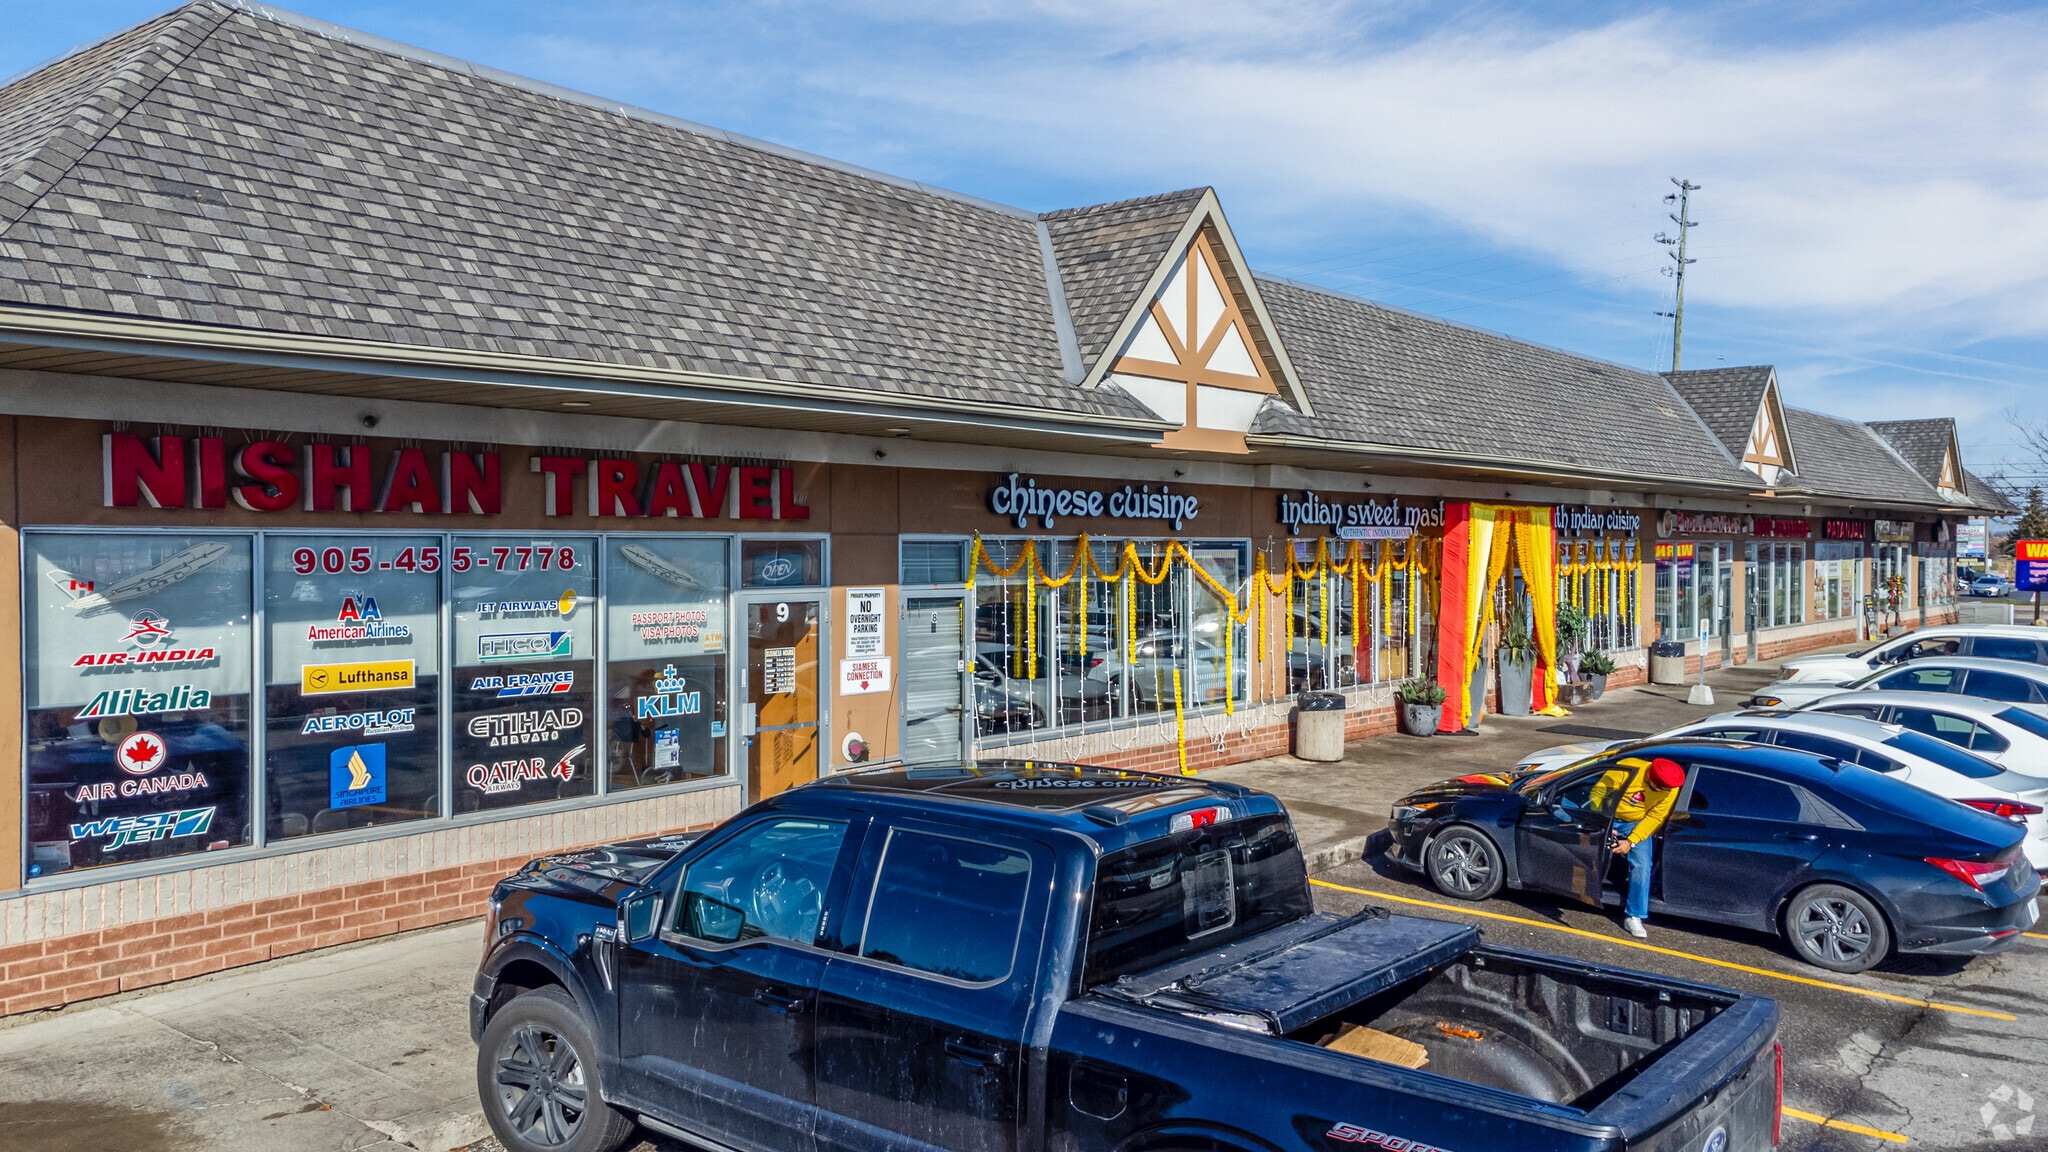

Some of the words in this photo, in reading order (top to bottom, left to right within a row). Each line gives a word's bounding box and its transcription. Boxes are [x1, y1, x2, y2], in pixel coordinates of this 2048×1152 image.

[103, 432, 501, 513] NISHAN
[531, 456, 810, 520] TRAVEL
[992, 473, 1104, 529] chinese
[1109, 484, 1199, 531] cuisine
[1281, 491, 1342, 535] indian
[1347, 498, 1400, 526] sweet
[1571, 506, 1604, 537] indian
[1607, 510, 1640, 537] cuisine
[1343, 527, 1371, 537] AUTHENTIC
[1373, 527, 1391, 537] INDIAN
[1827, 521, 1866, 538] PATANJALI
[293, 547, 576, 575] 905-455-7778
[762, 563, 791, 578] OPEN
[476, 602, 496, 613] JET
[500, 600, 557, 611] AIRWAYS
[776, 602, 789, 622] 9
[860, 600, 872, 613] NO
[632, 612, 673, 624] PASSPORT
[675, 611, 706, 622] PHOTOS
[850, 614, 881, 623] OVERNIGHT
[930, 612, 938, 624] 8
[641, 627, 661, 639] VISA
[663, 625, 699, 637] PHOTOS
[854, 624, 878, 633] PARKING
[482, 637, 549, 654] TICO
[704, 633, 722, 642] ATM
[72, 647, 215, 668] AIR-INDIA
[852, 662, 878, 671] SIAMESE
[339, 667, 408, 684] Lufthansa
[471, 677, 504, 690] AIR
[507, 671, 574, 686] FRANCE
[847, 671, 883, 681] CONNECTION
[75, 685, 211, 719] Alitalia
[637, 691, 700, 719] KLM
[302, 708, 415, 734] AEROFLOT
[365, 727, 390, 735] Russian
[392, 724, 414, 733] Airlines
[468, 708, 583, 737] ETIHAD
[490, 731, 559, 746] AIRWAYS
[467, 757, 548, 790] QATAR
[76, 782, 116, 802] AIR
[121, 772, 208, 796] CANADA
[334, 785, 384, 798] SINGAPORE
[486, 781, 520, 793] AIRWAYS
[340, 795, 377, 806] AIRLINES
[71, 811, 179, 839] WEST
[103, 824, 174, 852] JET
[1326, 1121, 1454, 1152] SPOR
